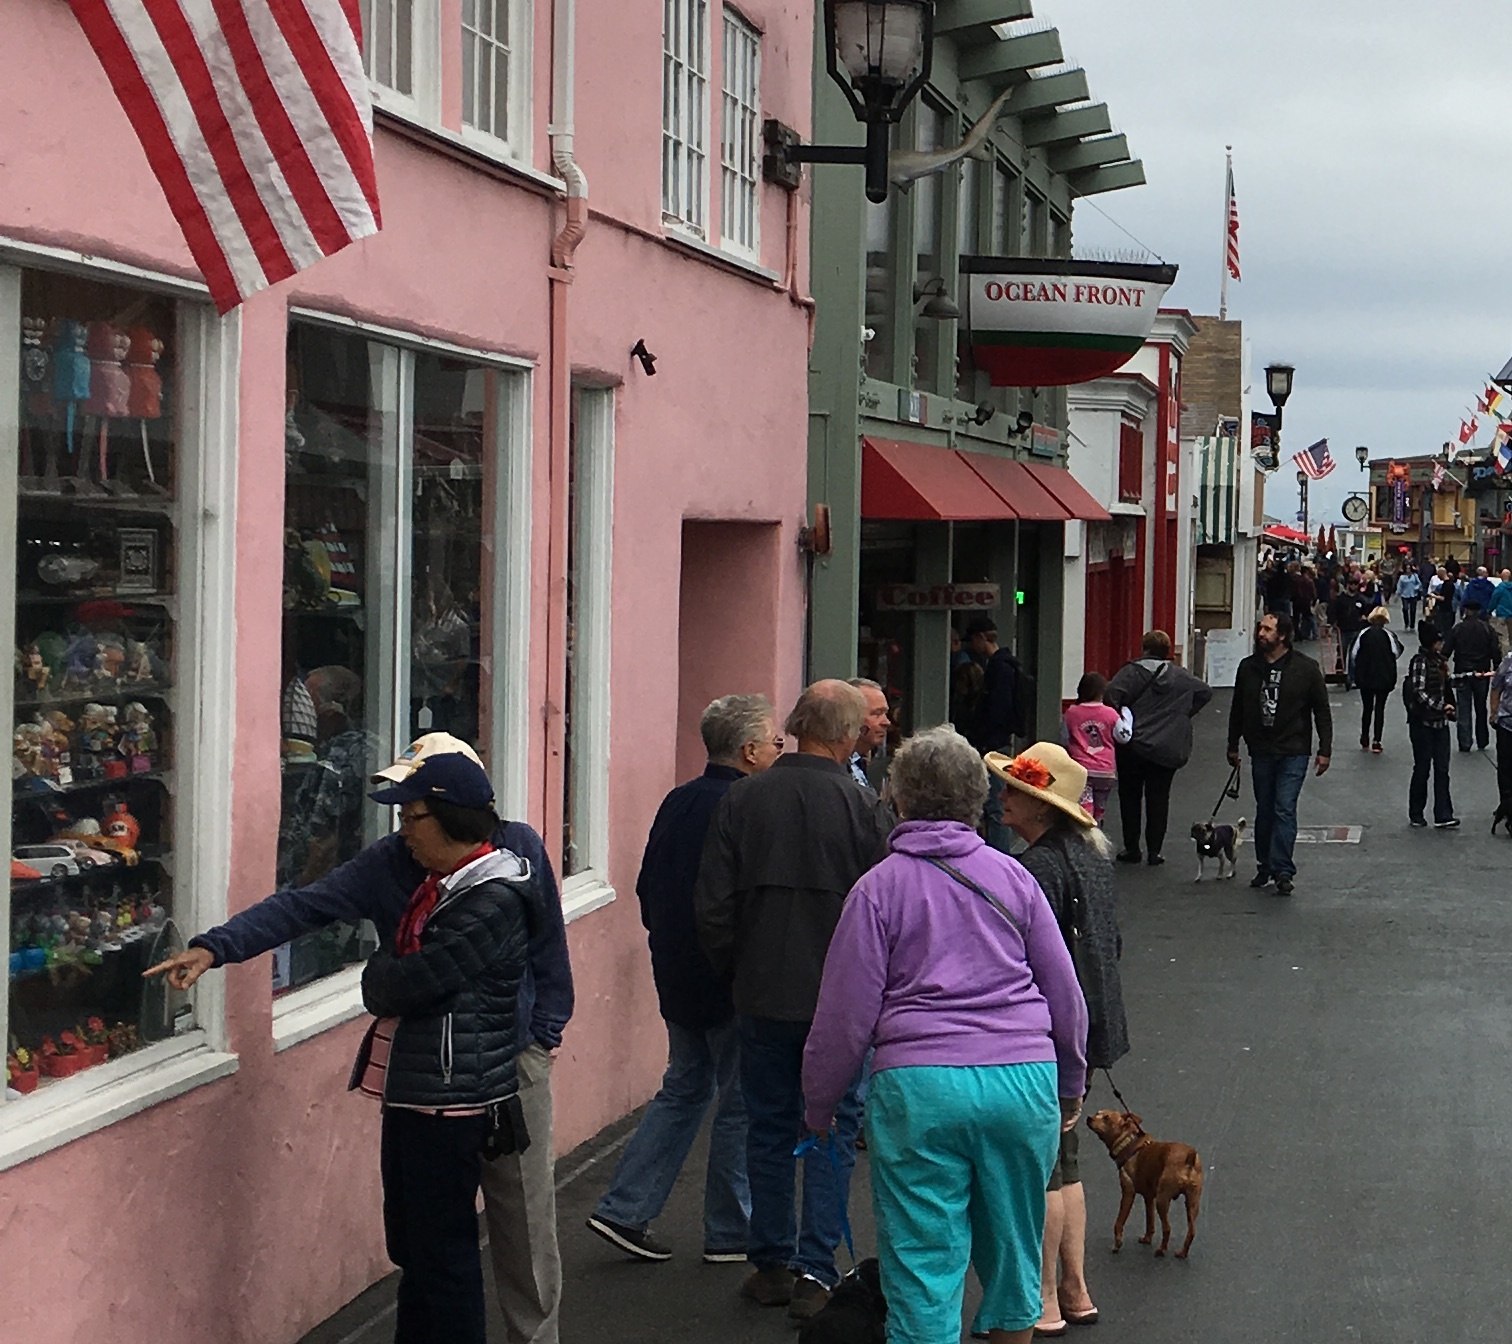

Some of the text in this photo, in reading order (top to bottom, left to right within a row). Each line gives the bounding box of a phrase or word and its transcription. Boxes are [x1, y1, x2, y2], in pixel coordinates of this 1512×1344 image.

[985, 281, 1145, 307] OCEAN FRONT
[883, 585, 994, 606] Coffee
